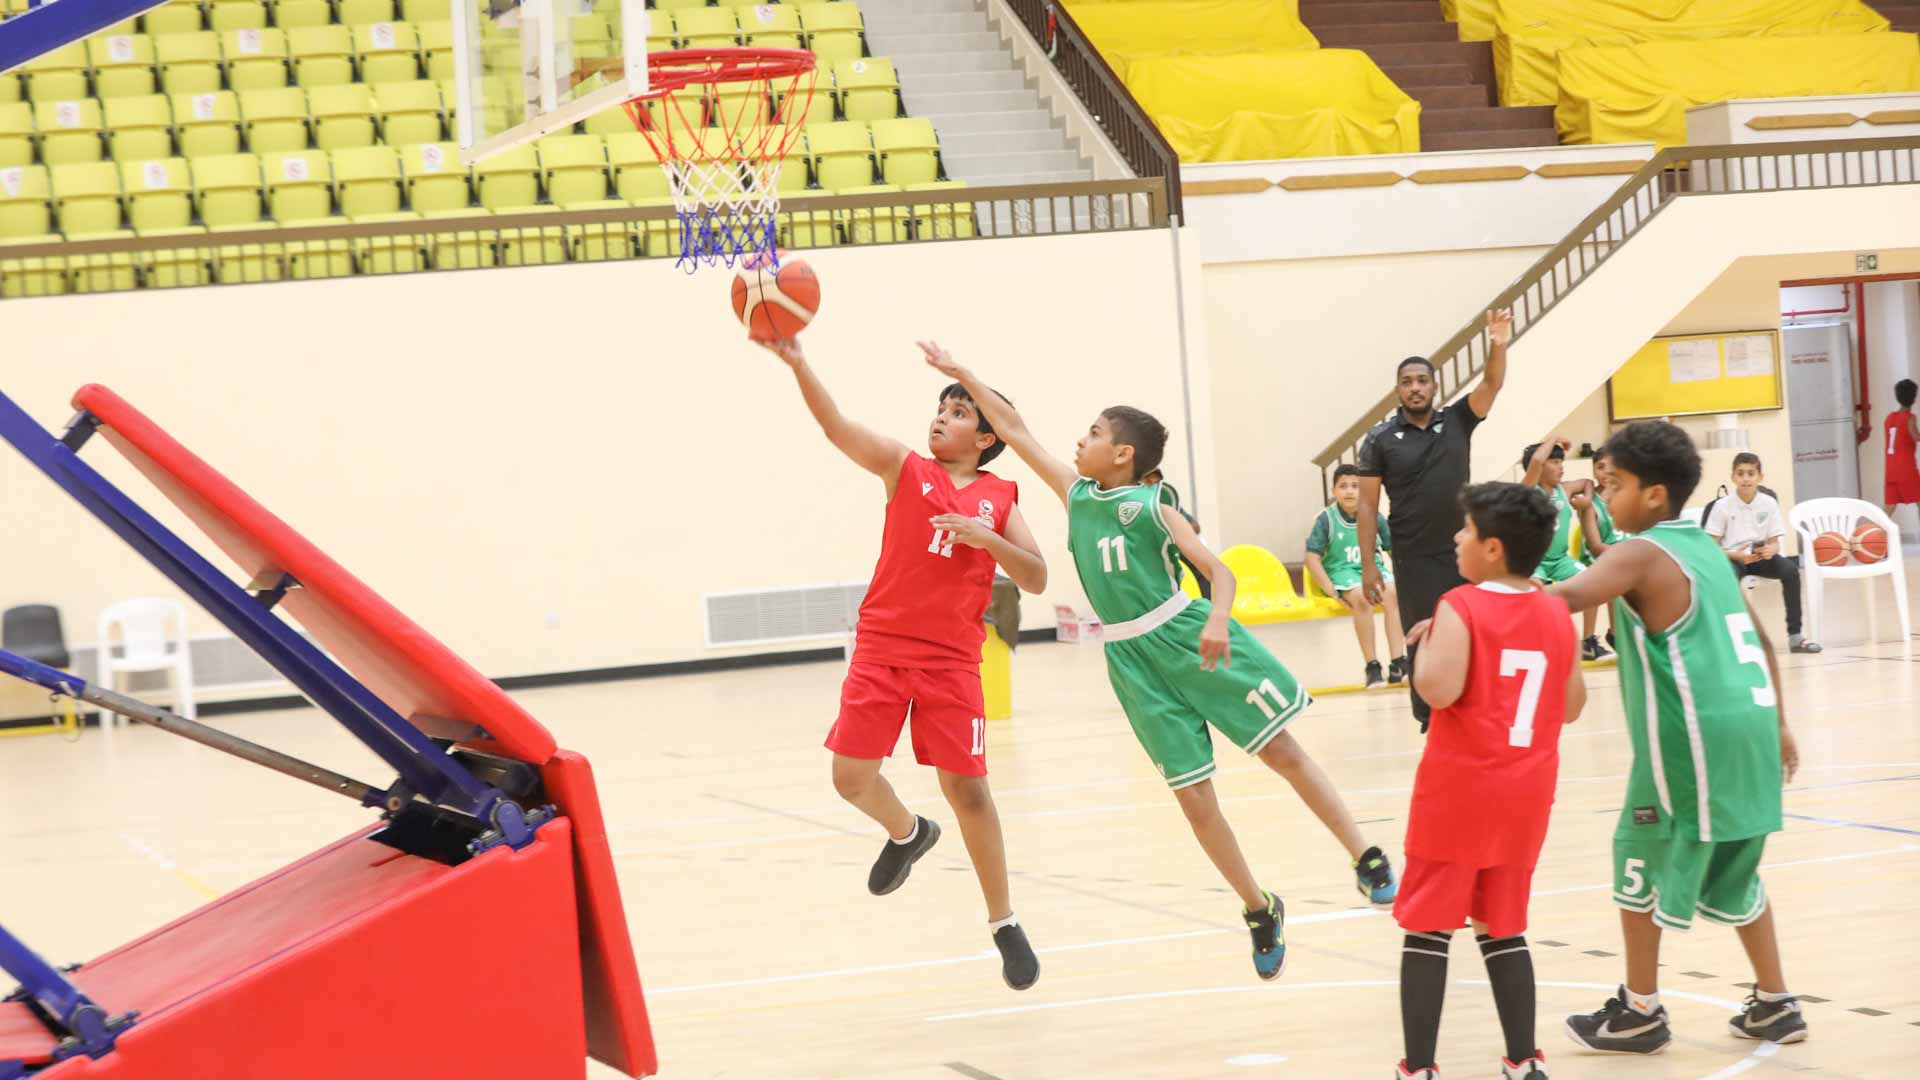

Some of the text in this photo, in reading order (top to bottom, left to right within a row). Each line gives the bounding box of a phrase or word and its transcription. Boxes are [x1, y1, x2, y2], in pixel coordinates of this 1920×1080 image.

[1887, 427, 1897, 454] 1
[1097, 535, 1128, 573] 11
[1344, 546, 1362, 564] 10
[1724, 611, 1777, 706] 5
[1246, 678, 1290, 720] 11
[1499, 648, 1548, 748] 7
[1622, 858, 1645, 895] 5
